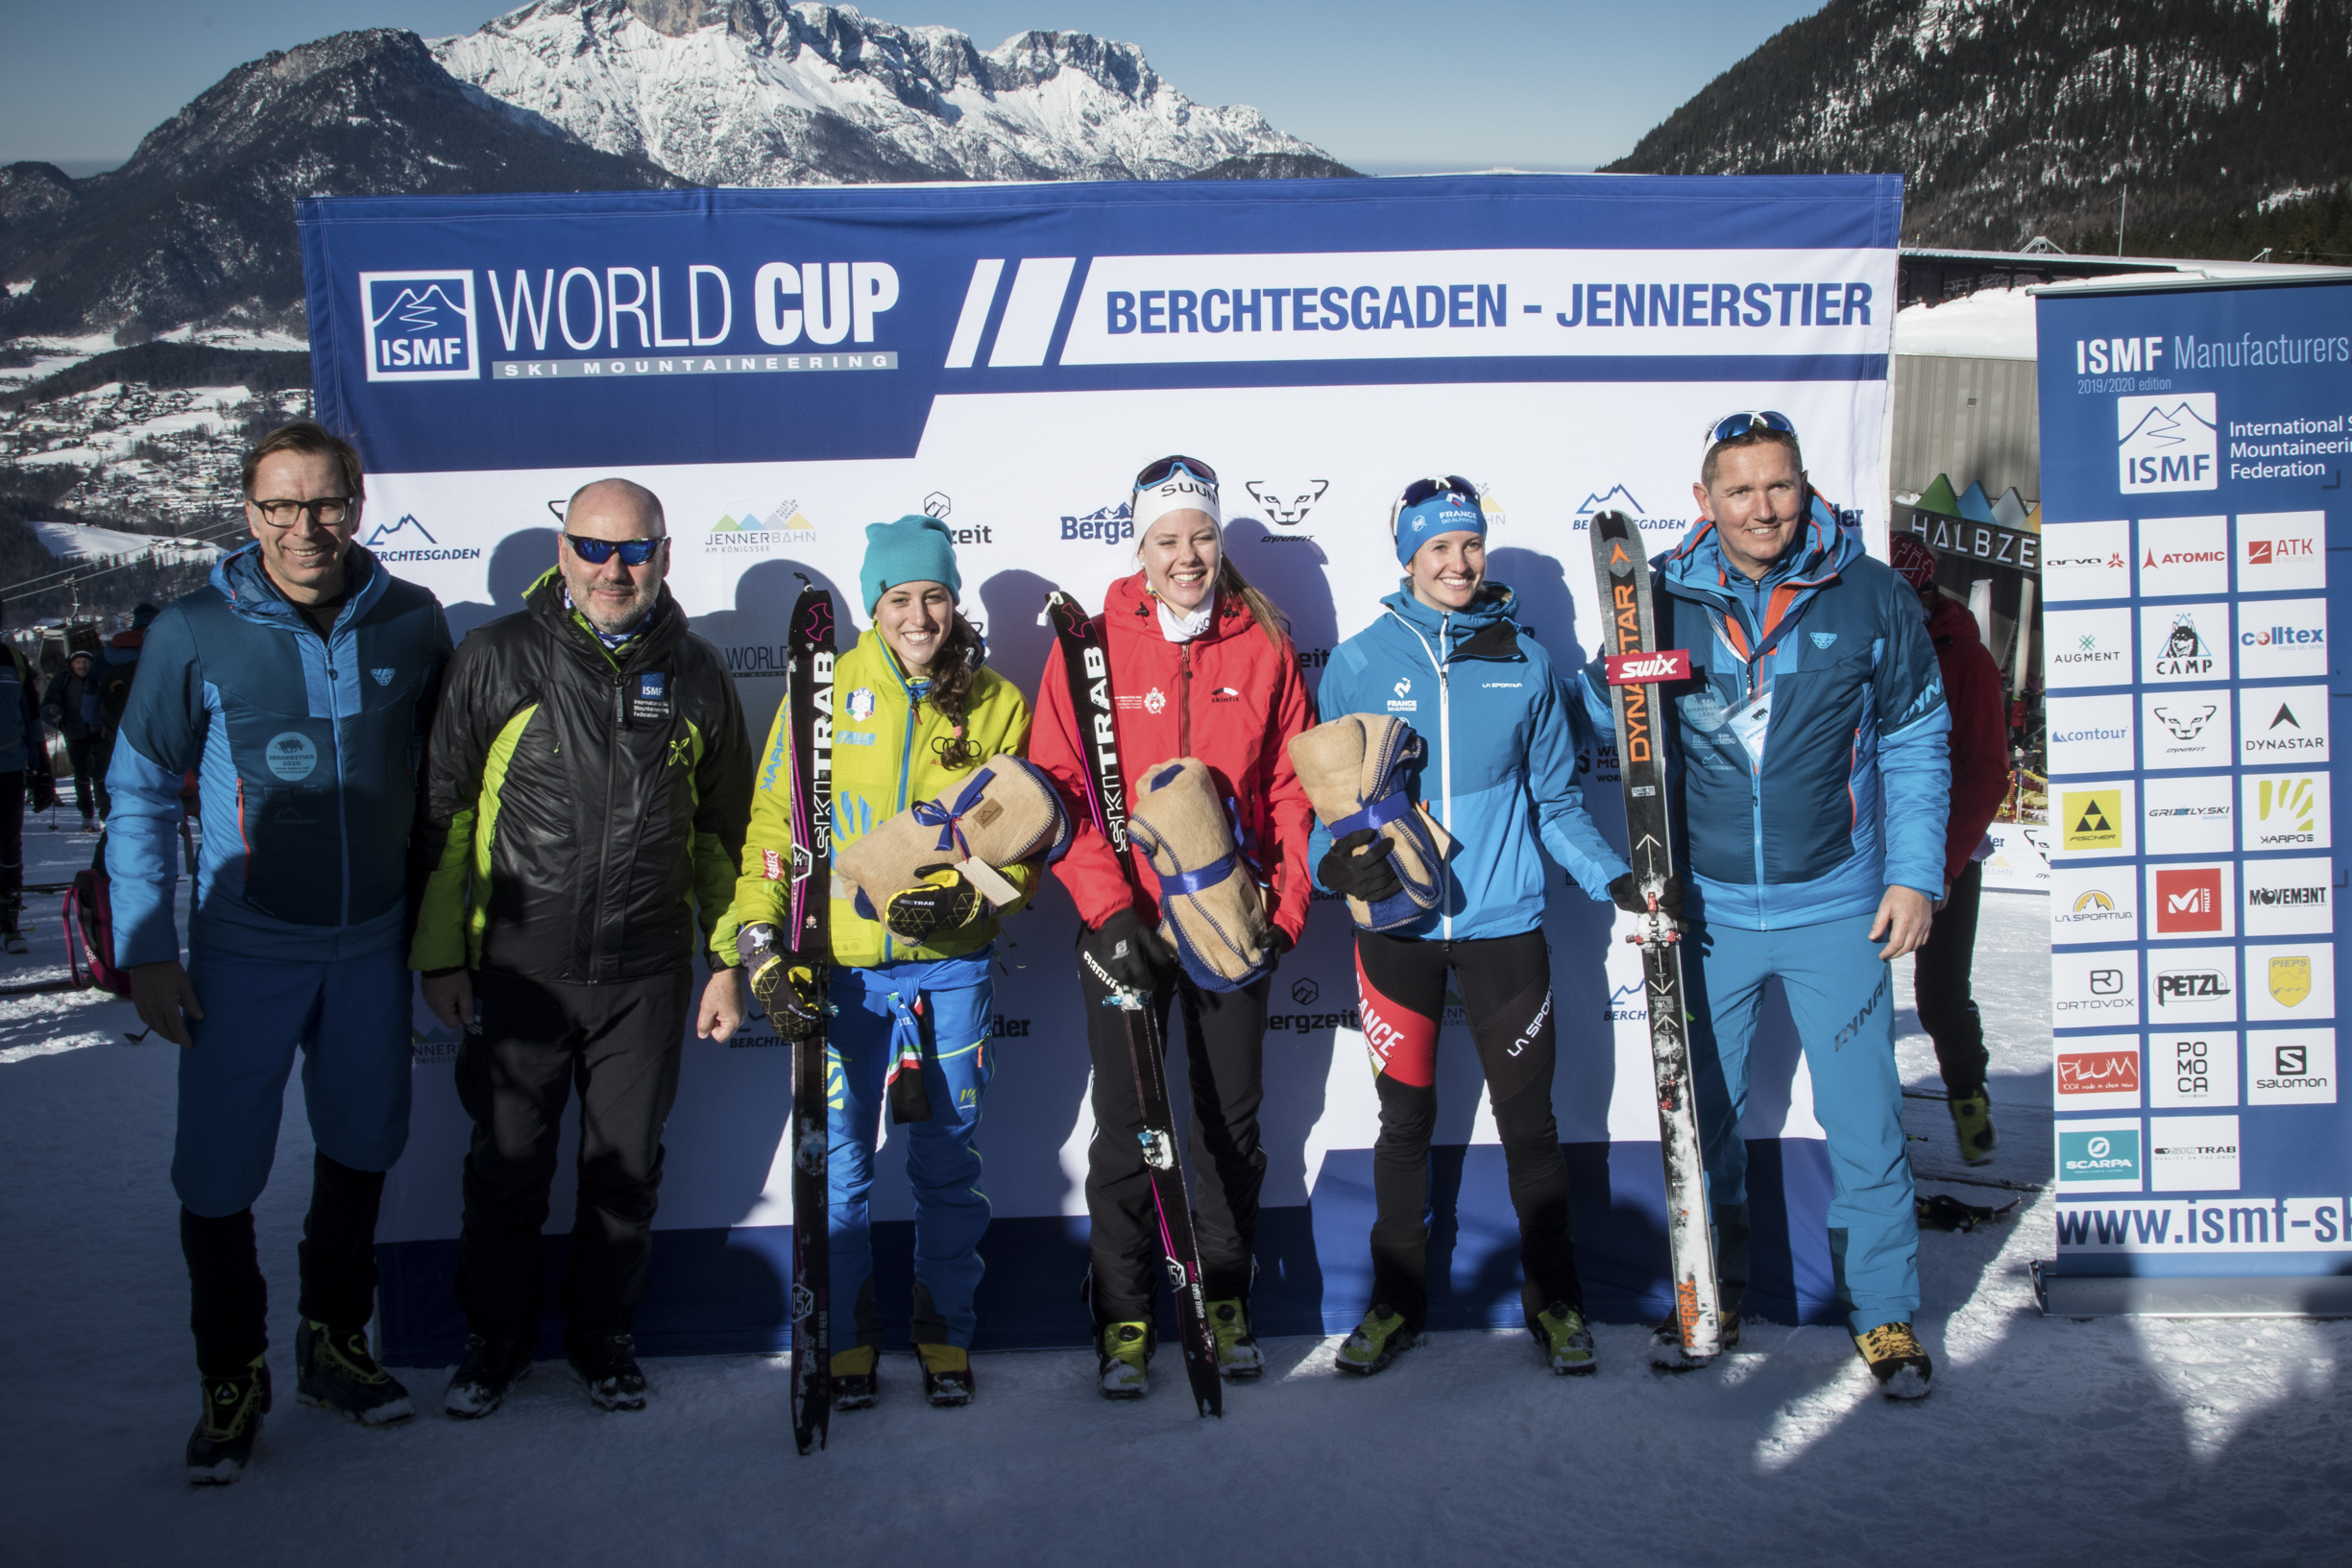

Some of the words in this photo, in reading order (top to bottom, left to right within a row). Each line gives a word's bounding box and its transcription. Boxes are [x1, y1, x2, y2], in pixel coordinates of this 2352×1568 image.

[488, 265, 733, 352] WORLD
[754, 261, 901, 347] CUP
[1106, 283, 1508, 336] BERCHTESGADEN
[1556, 280, 1873, 329] JENNERSTIER
[381, 338, 463, 368] ISMF
[2076, 336, 2163, 374] ISMF
[2174, 332, 2349, 371] Manufacturers
[504, 362, 560, 378] SKI
[583, 354, 889, 376] MOUNTAINEERING
[2077, 378, 2136, 395] 2019/2020
[2138, 376, 2171, 393] edition
[2229, 417, 2343, 438] International
[2229, 437, 2352, 459] Mountaineeri
[2128, 454, 2211, 484] ISMF
[2230, 461, 2326, 480] Federation
[1160, 481, 1219, 506] SUUN
[1439, 510, 1478, 520] FRANCE
[705, 531, 816, 545] JENNERBAHN
[953, 525, 993, 545] zeit
[1060, 516, 1133, 545] Berga
[1260, 535, 1315, 544] DYNAFIT
[719, 543, 770, 554] KÖNIGSSEE
[1911, 514, 2041, 568] HALBZE
[2275, 538, 2314, 556] ATK
[374, 547, 481, 563] ERCHTESGADEN
[2047, 557, 2102, 567] arva
[2161, 550, 2225, 564] ATOMIC
[2274, 553, 2315, 564] BINDINGS
[2241, 626, 2324, 648] colltex
[2054, 651, 2120, 663] AUGMENT
[2156, 659, 2213, 676] CAMP
[643, 687, 663, 696] ISMF
[2067, 727, 2127, 742] contour
[2245, 737, 2324, 751] DYNASTAR
[813, 651, 835, 858] SKITRAB
[1083, 645, 1129, 854] SKITRAB
[2070, 833, 2117, 842] FISCHER
[2260, 833, 2315, 845] KARPOS
[2271, 958, 2308, 968] PIEPS
[2157, 974, 2231, 1007] PETZL
[2056, 998, 2134, 1011] ORTOVOX
[1507, 1038, 1529, 1057] LA
[2176, 1041, 2207, 1057] PO
[2058, 1055, 2137, 1082] PLUM
[2176, 1059, 2207, 1075] MO
[2177, 1076, 2208, 1093] CA
[2066, 1158, 2132, 1170] SCARPA
[1166, 1265, 1185, 1286] 152
[1186, 1261, 1198, 1283] SPRINT
[791, 1291, 812, 1315] 152
[818, 1310, 829, 1328] AERO
[818, 1328, 829, 1349] GARA
